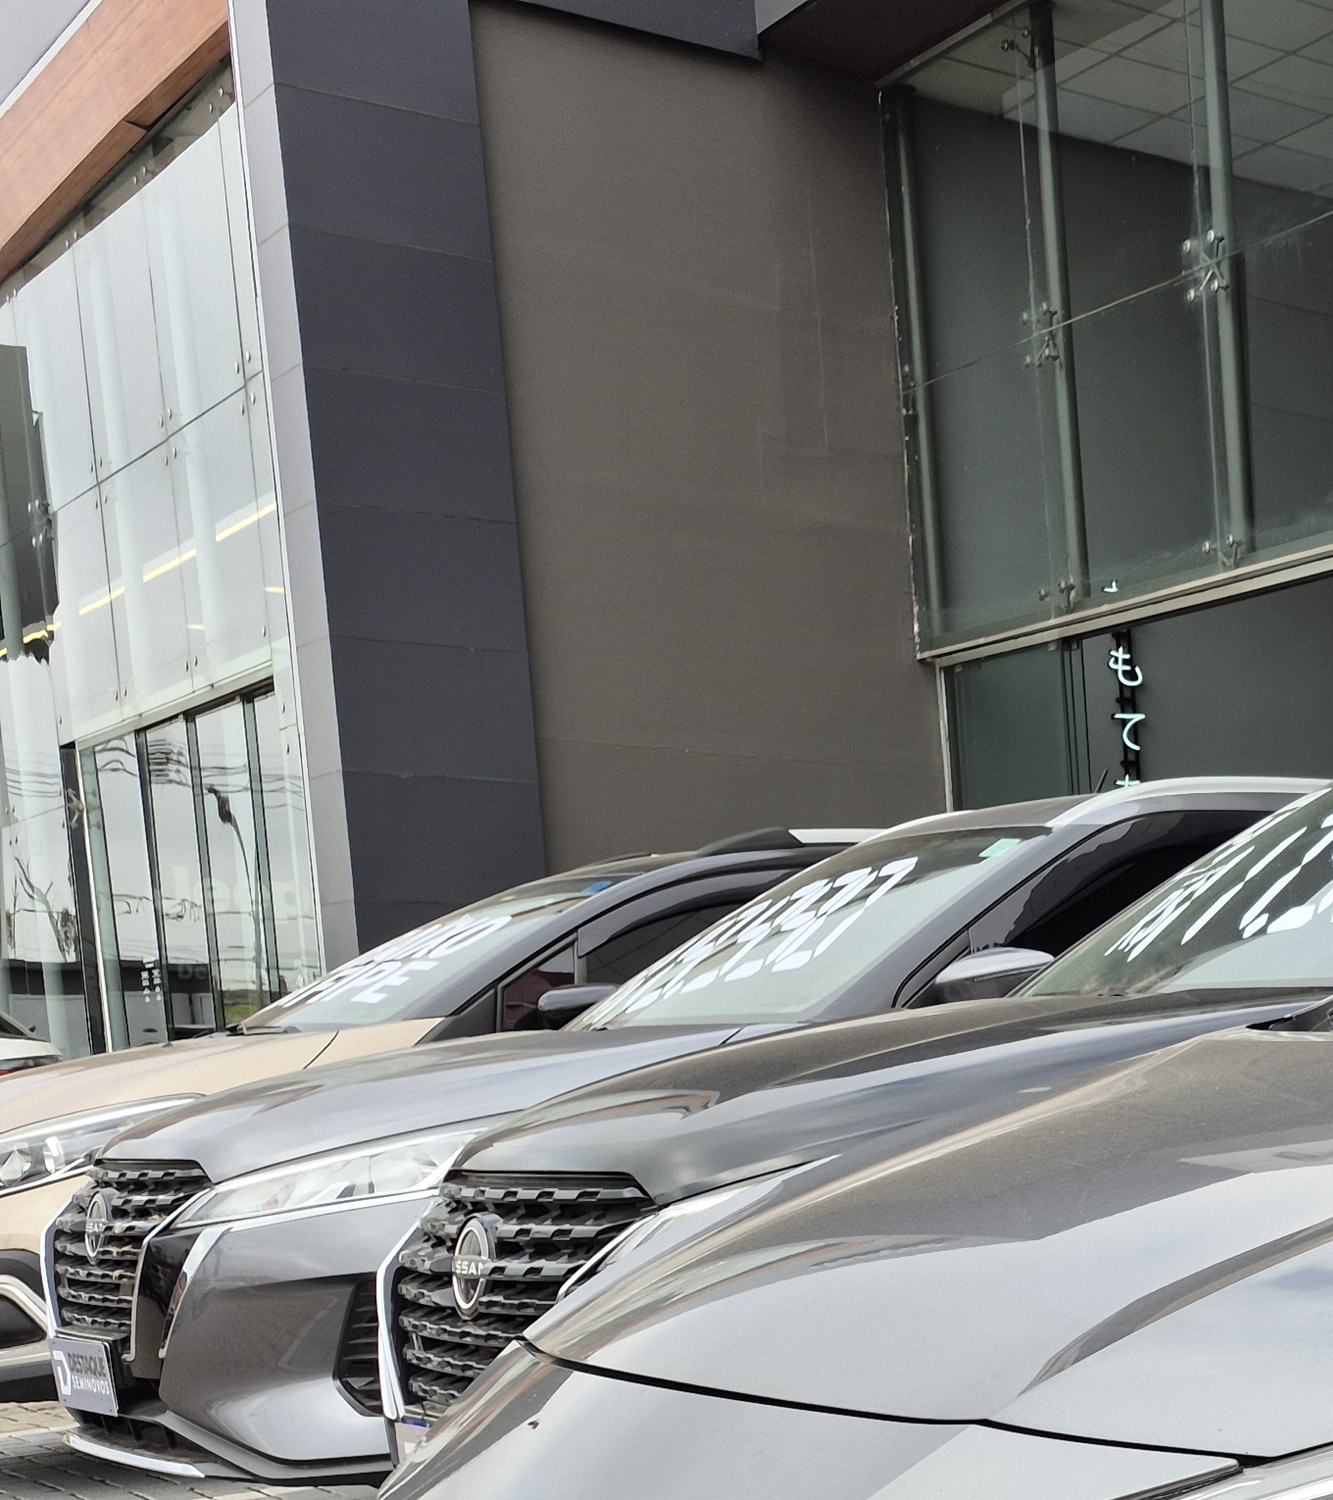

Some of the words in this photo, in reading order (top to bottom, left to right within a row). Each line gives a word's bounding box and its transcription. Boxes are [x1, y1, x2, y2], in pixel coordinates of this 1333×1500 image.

[1107, 646, 1146, 787] もて
[67, 1352, 107, 1378] DESTAQUE
[71, 1375, 111, 1395] SEMINOVOS
